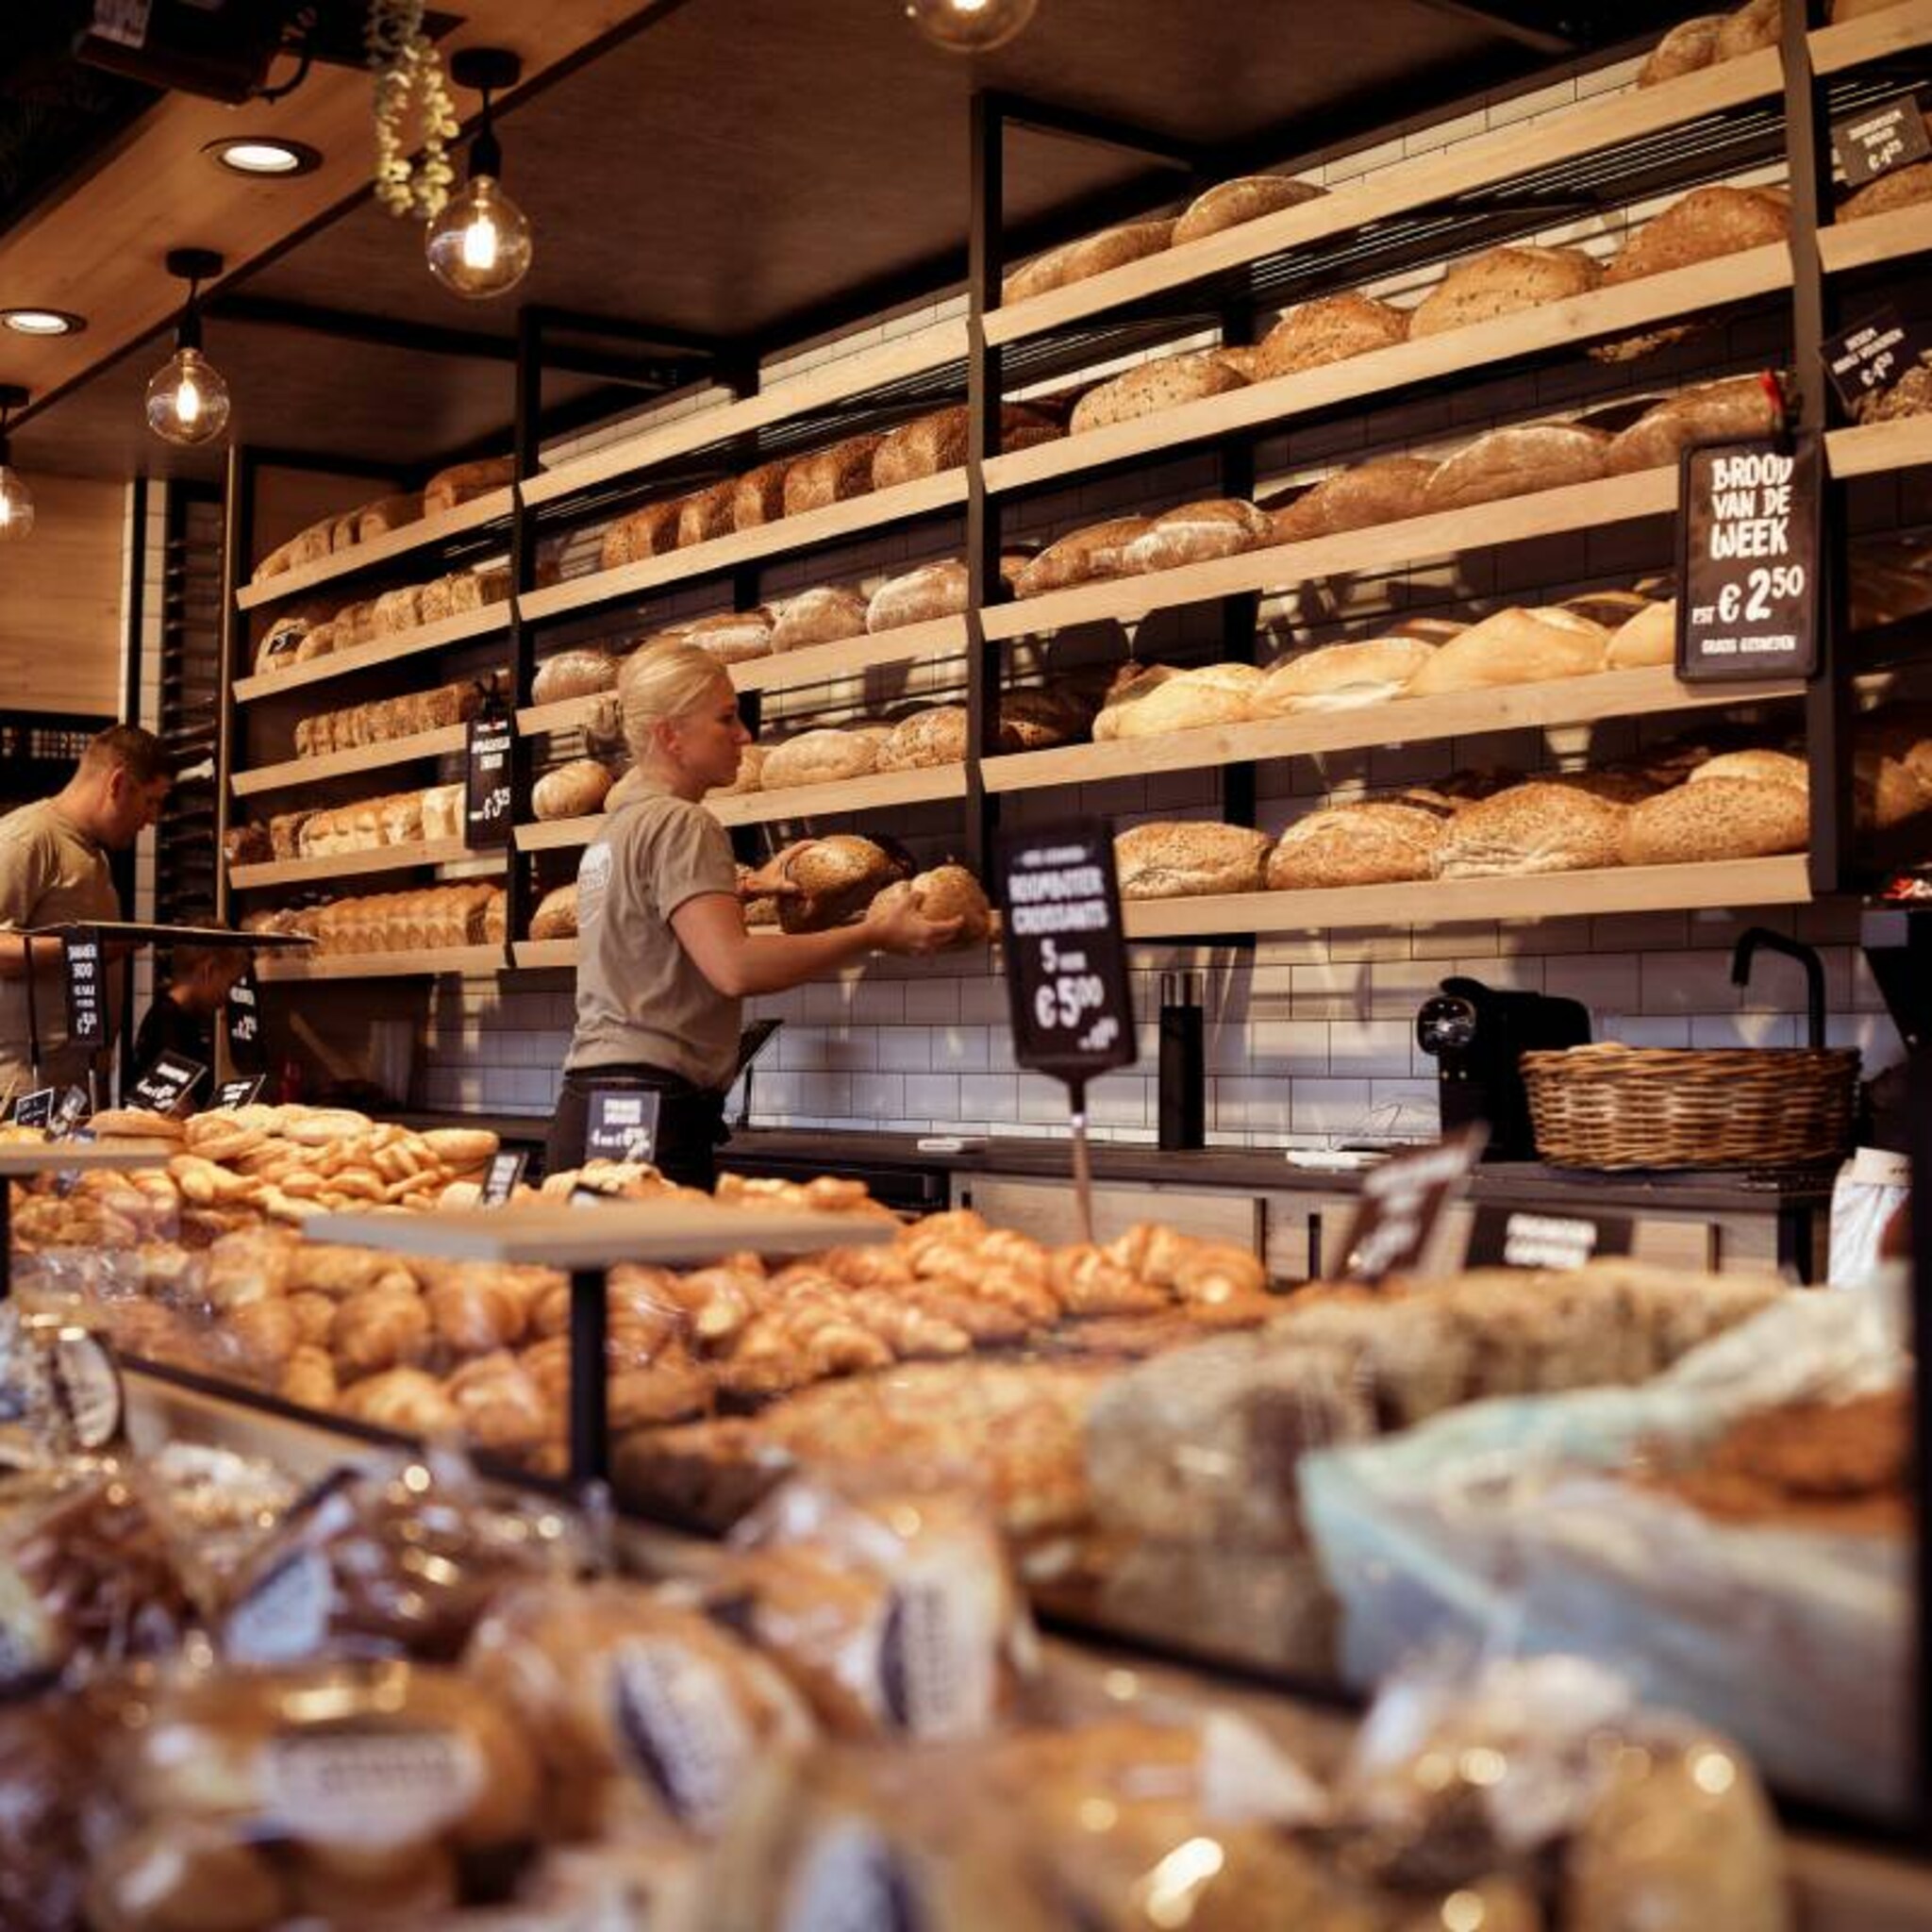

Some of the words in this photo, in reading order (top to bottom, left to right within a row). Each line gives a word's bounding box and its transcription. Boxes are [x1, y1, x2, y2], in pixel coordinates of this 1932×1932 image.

[1712, 453, 1794, 491] BROOD
[1711, 490, 1756, 520] VAN
[1763, 485, 1791, 515] DE
[1709, 517, 1790, 559] WEEK
